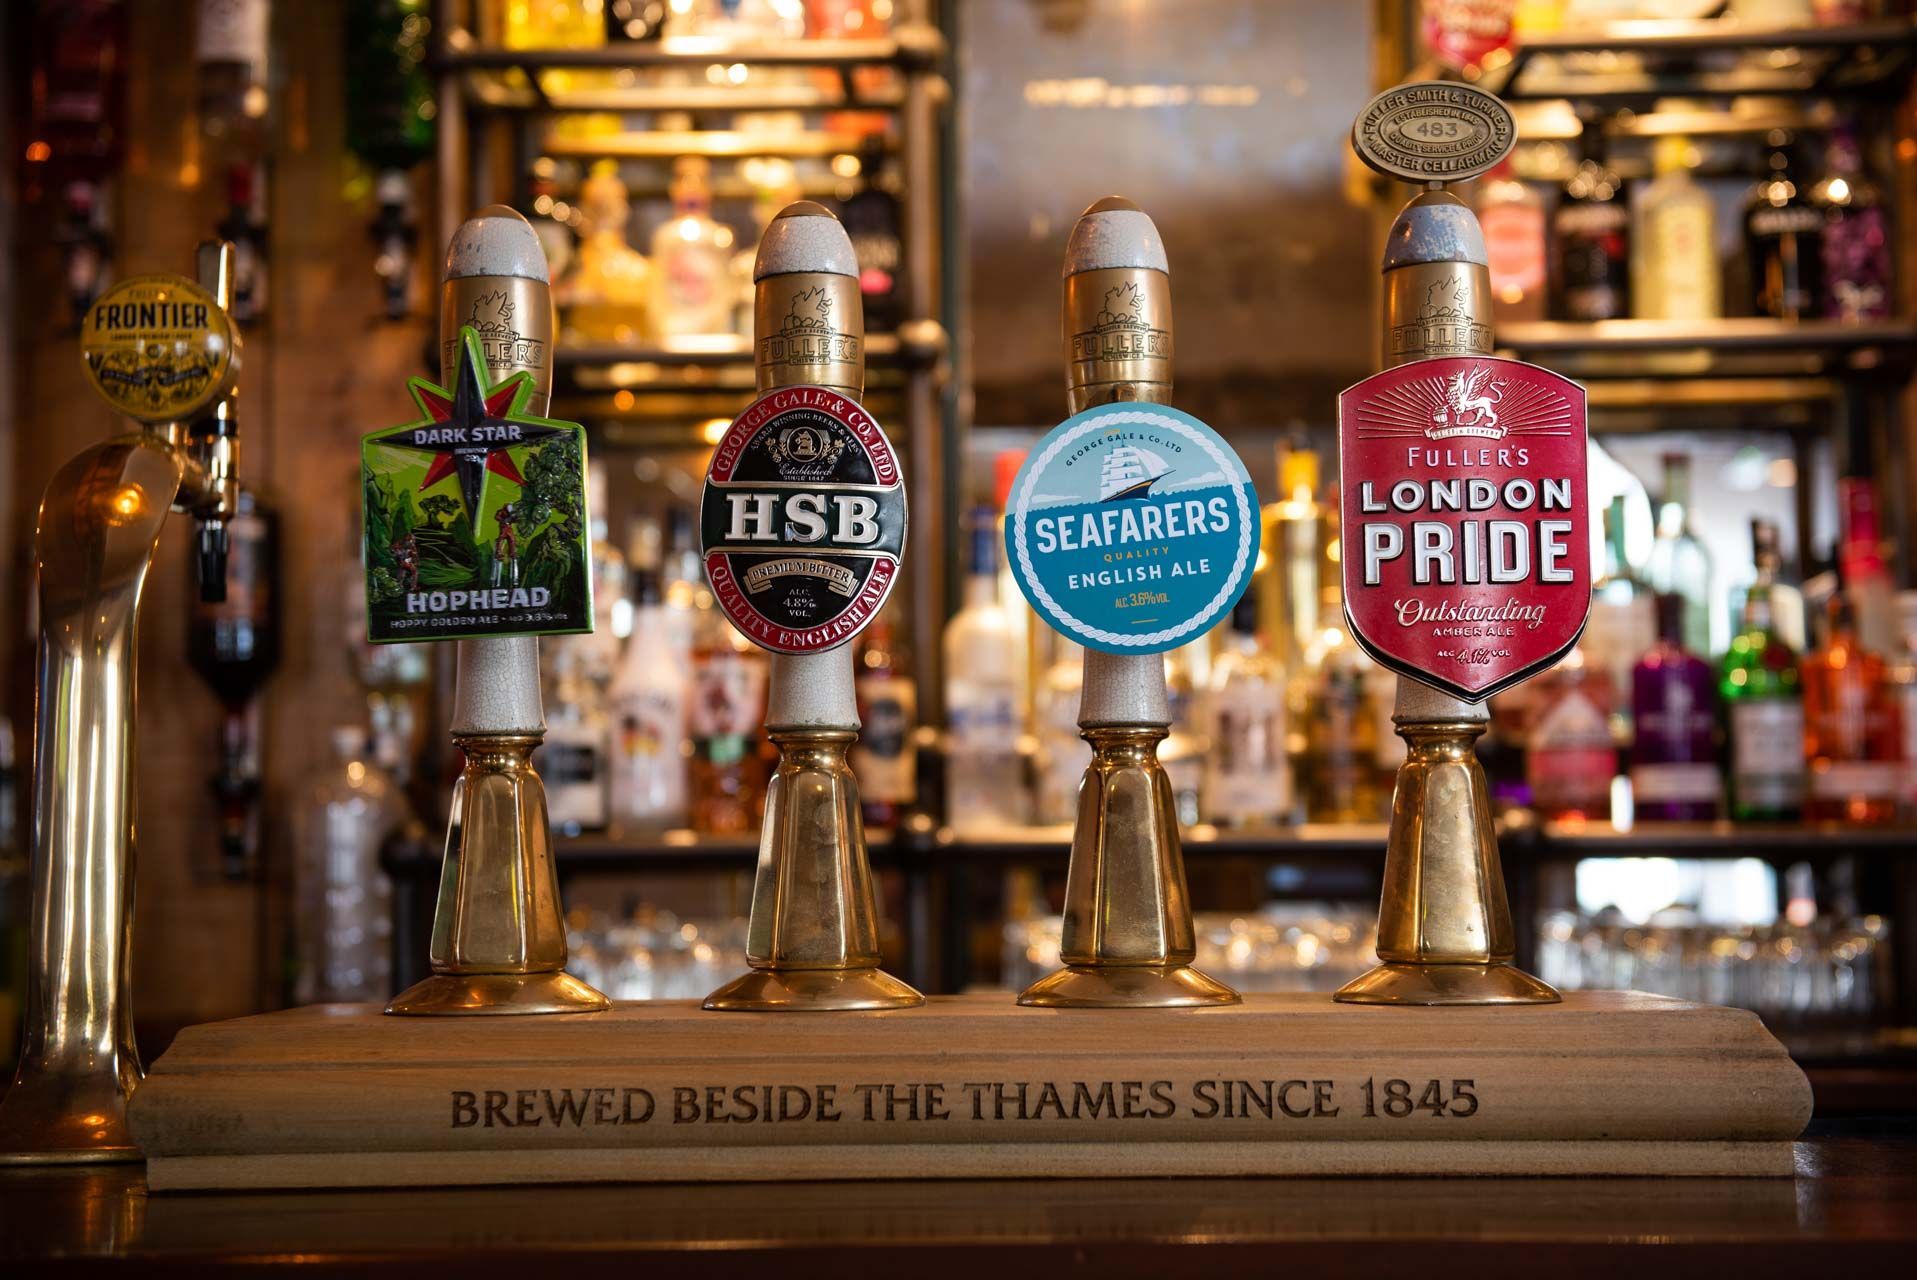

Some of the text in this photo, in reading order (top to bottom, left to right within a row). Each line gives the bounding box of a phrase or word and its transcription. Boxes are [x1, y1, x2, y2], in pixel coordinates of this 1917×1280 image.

[1364, 89, 1508, 137] FULLER SMITH & TURNER
[1394, 107, 1450, 125] ESTABLISHED
[1417, 122, 1458, 138] 483
[1389, 132, 1421, 153] QUALITY
[1421, 143, 1455, 153] SERVICE
[1462, 133, 1483, 151] PRIDE
[1369, 140, 1503, 173] MASTER CELLARMAN
[95, 302, 209, 331] FRONTIER
[760, 338, 858, 362] FULLER'S
[1072, 333, 1169, 359] FULLER'S
[1391, 327, 1491, 351] FULLER'S
[790, 356, 826, 365] CHISWICK
[1105, 352, 1141, 361] CHISWICK
[414, 425, 522, 445] DARK STAR
[716, 390, 893, 477] GEORGE GALE & CO. LTD
[751, 426, 773, 450] AWARD
[773, 413, 812, 427] WINNING
[812, 414, 840, 432] BEERS
[1066, 438, 1104, 467] GEORGE
[1107, 432, 1135, 442] GALE
[1165, 440, 1182, 454] LTD
[1408, 445, 1530, 468] FULLER'S
[779, 462, 835, 477] Established
[1361, 478, 1572, 513] LONDON
[724, 493, 879, 545] HSB
[1035, 497, 1231, 554] SEAFARERS
[1103, 546, 1169, 563] QUALITY
[1363, 520, 1575, 585] PRIDE
[752, 563, 850, 582] PREMIUM BITTER
[1068, 558, 1211, 589] ENGLISH ALE
[407, 587, 550, 614] HOPHEAD
[712, 566, 889, 647] QUALITY ENGLISH ALE
[782, 597, 817, 609] 4.8%
[1129, 591, 1156, 607] 3.6%
[390, 618, 429, 629] HOPPY
[430, 616, 476, 627] GOLDEN
[478, 615, 499, 624] ALE
[1393, 597, 1547, 630] Outstanding
[1432, 626, 1515, 637] AMBER ALE
[1456, 648, 1490, 664] 4.1%
[1491, 649, 1511, 657] VOL
[450, 1075, 1479, 1129] BREWED BESIDE THE THAMES SINCE 1845
